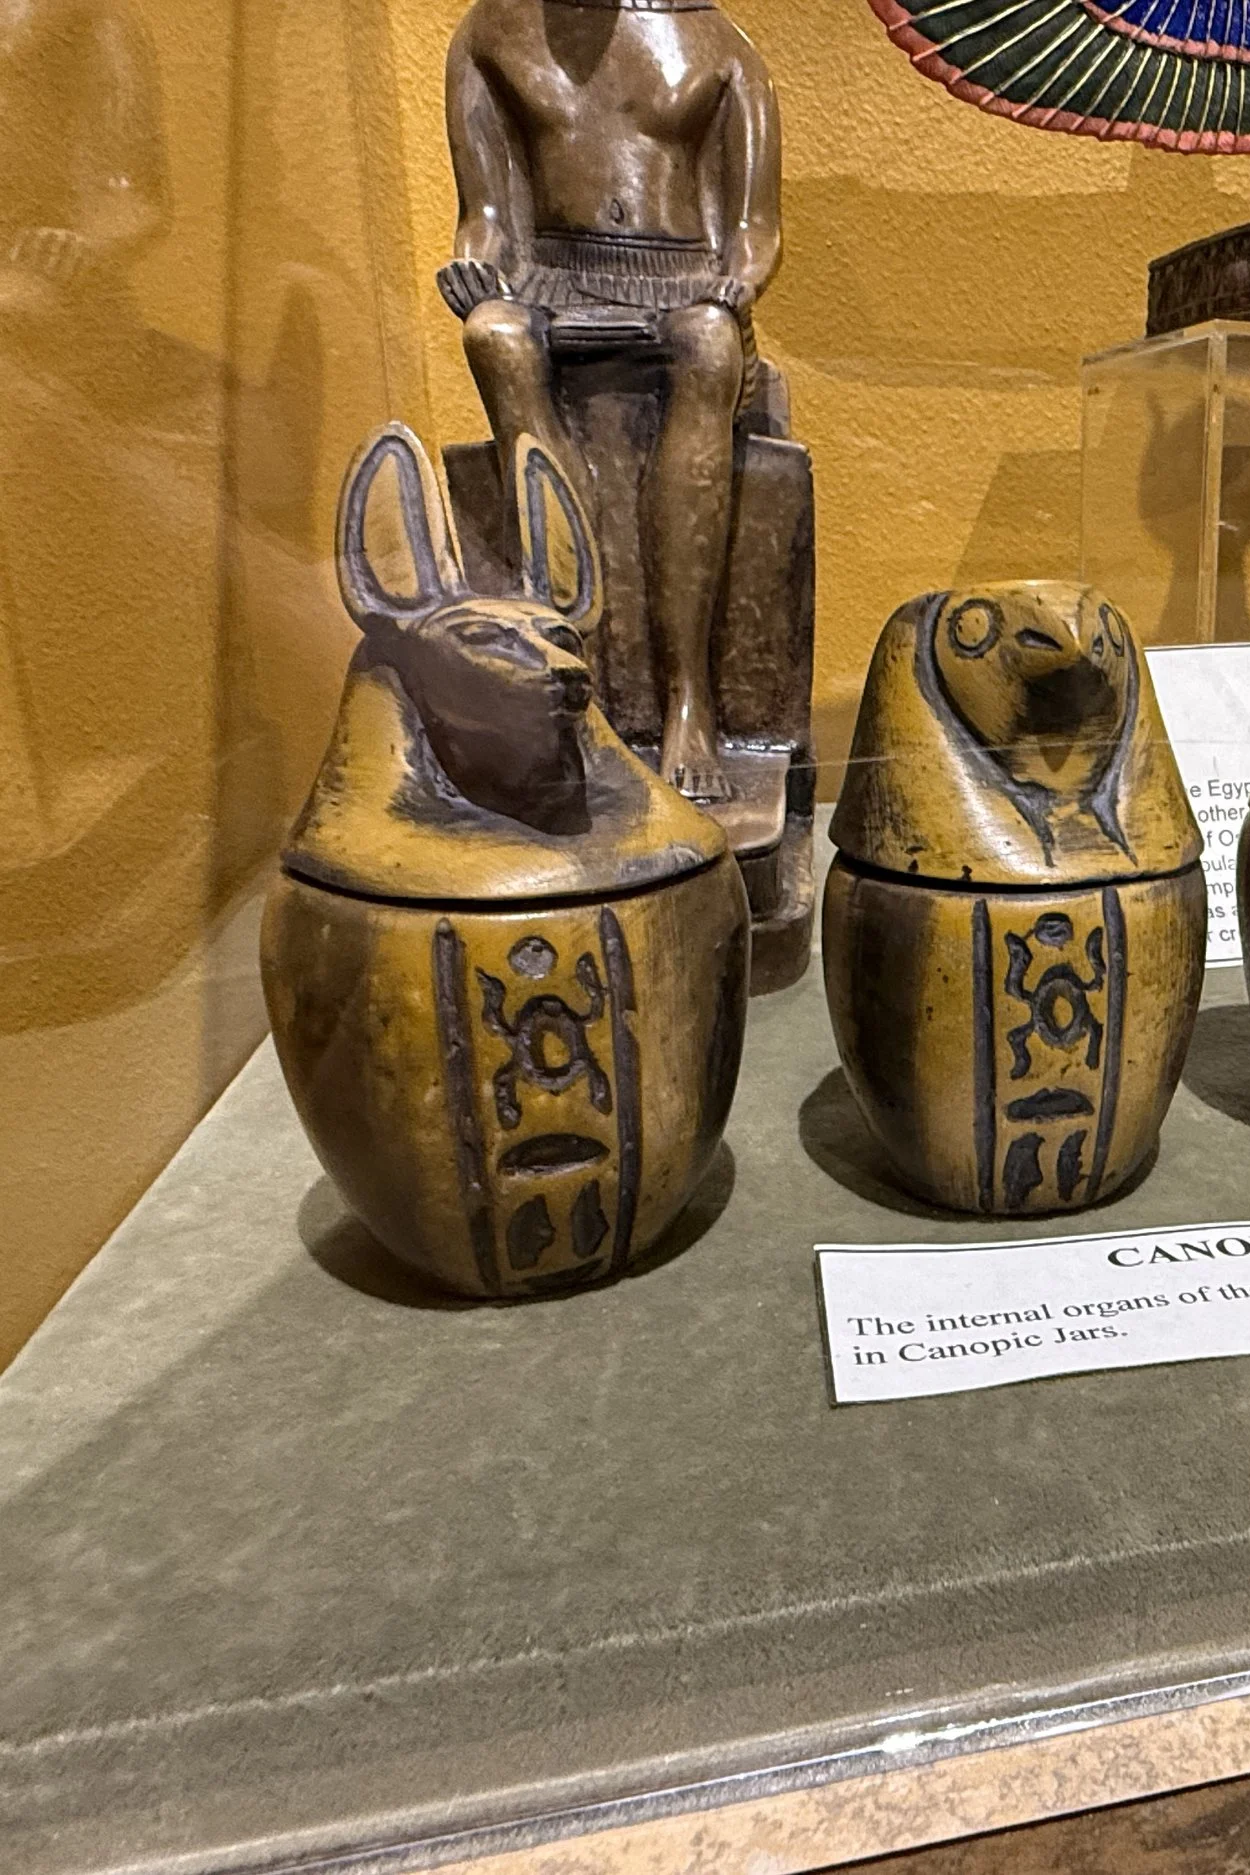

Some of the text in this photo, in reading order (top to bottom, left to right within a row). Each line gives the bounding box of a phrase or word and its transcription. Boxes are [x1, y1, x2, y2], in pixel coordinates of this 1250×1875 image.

[1197, 804, 1245, 823] other
[847, 1316, 916, 1337] The
[926, 1303, 1052, 1333] internal
[1063, 1291, 1170, 1318] organs
[1178, 1285, 1211, 1306] of
[852, 1322, 1130, 1366] in Canopic Jars.
